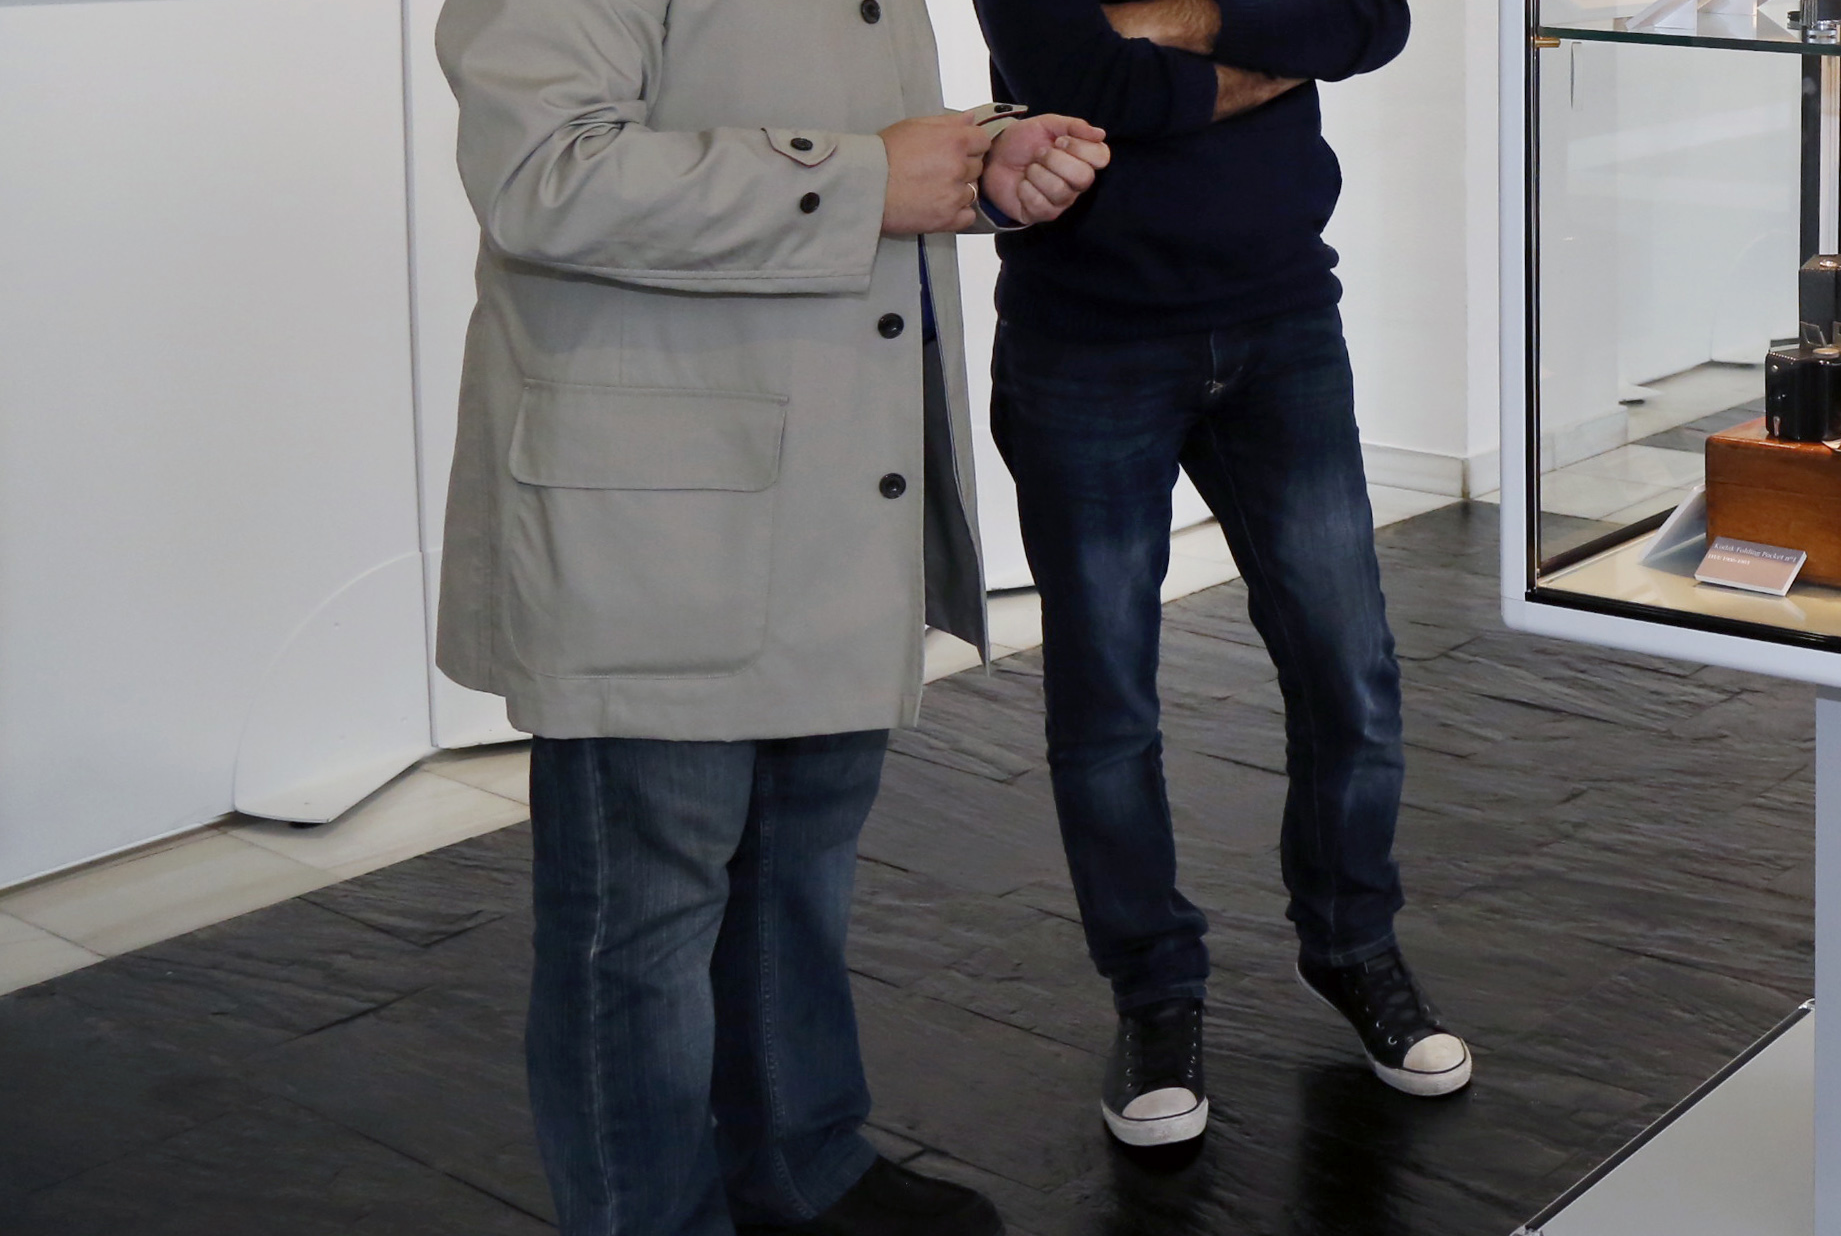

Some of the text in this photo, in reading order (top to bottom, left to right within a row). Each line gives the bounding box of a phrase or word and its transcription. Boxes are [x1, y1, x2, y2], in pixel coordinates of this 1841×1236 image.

[1713, 543, 1734, 552] Kodak
[1735, 546, 1761, 556] Folding
[1761, 550, 1784, 561] Pocket
